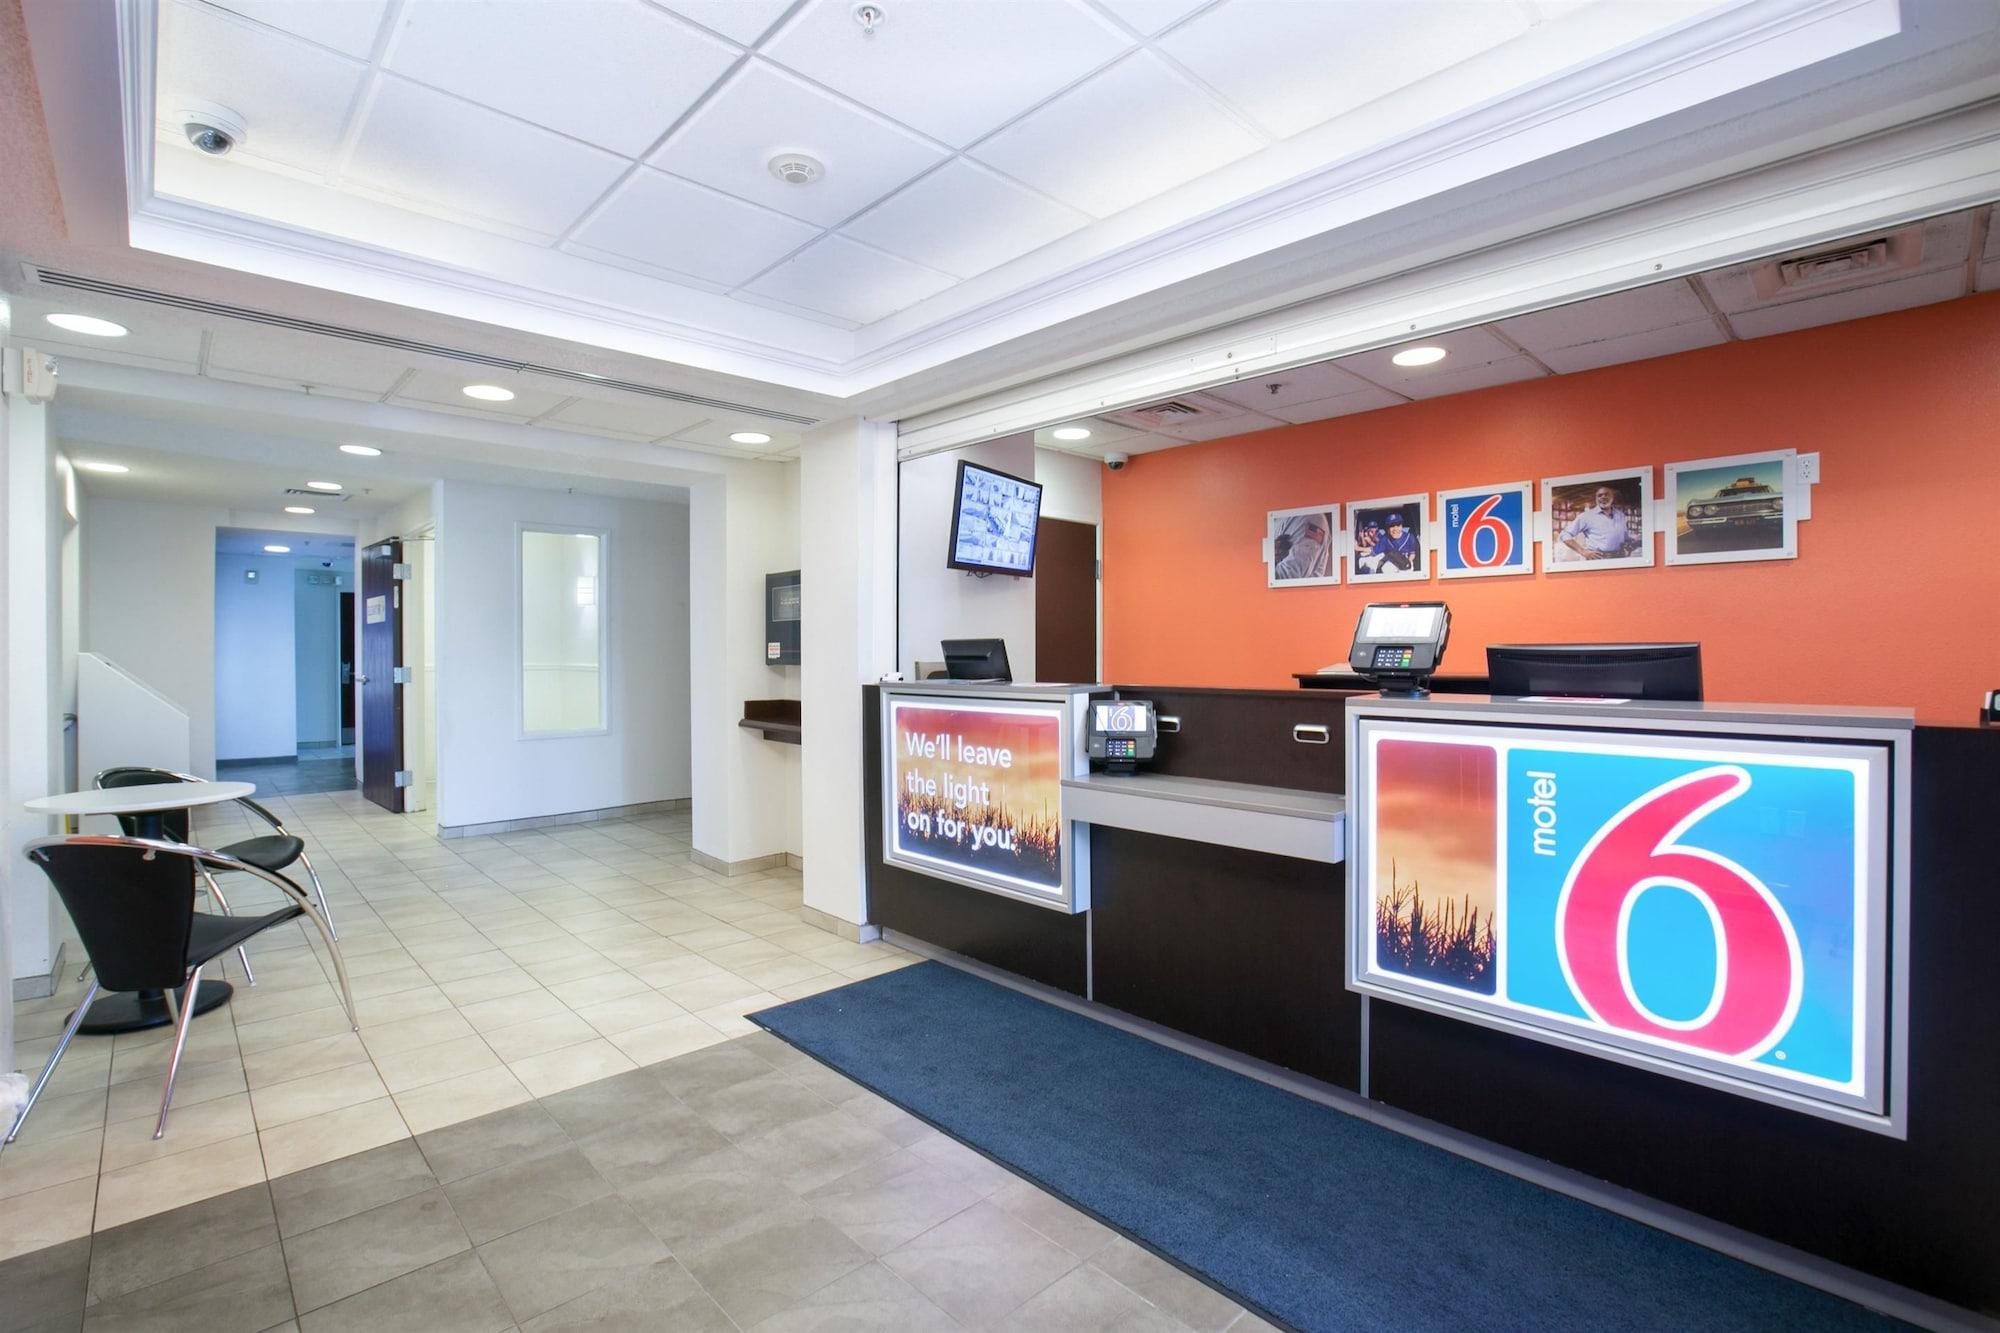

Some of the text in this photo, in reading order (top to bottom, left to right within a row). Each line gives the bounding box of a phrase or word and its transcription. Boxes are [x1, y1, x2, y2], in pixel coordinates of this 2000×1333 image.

[1451, 494, 1513, 568] motel 6
[1112, 705, 1133, 731] 6
[905, 731, 1012, 768] We'll leave
[906, 767, 990, 809] the light
[907, 811, 931, 833] on
[936, 808, 966, 839] for
[1526, 765, 1804, 1064] motel 6
